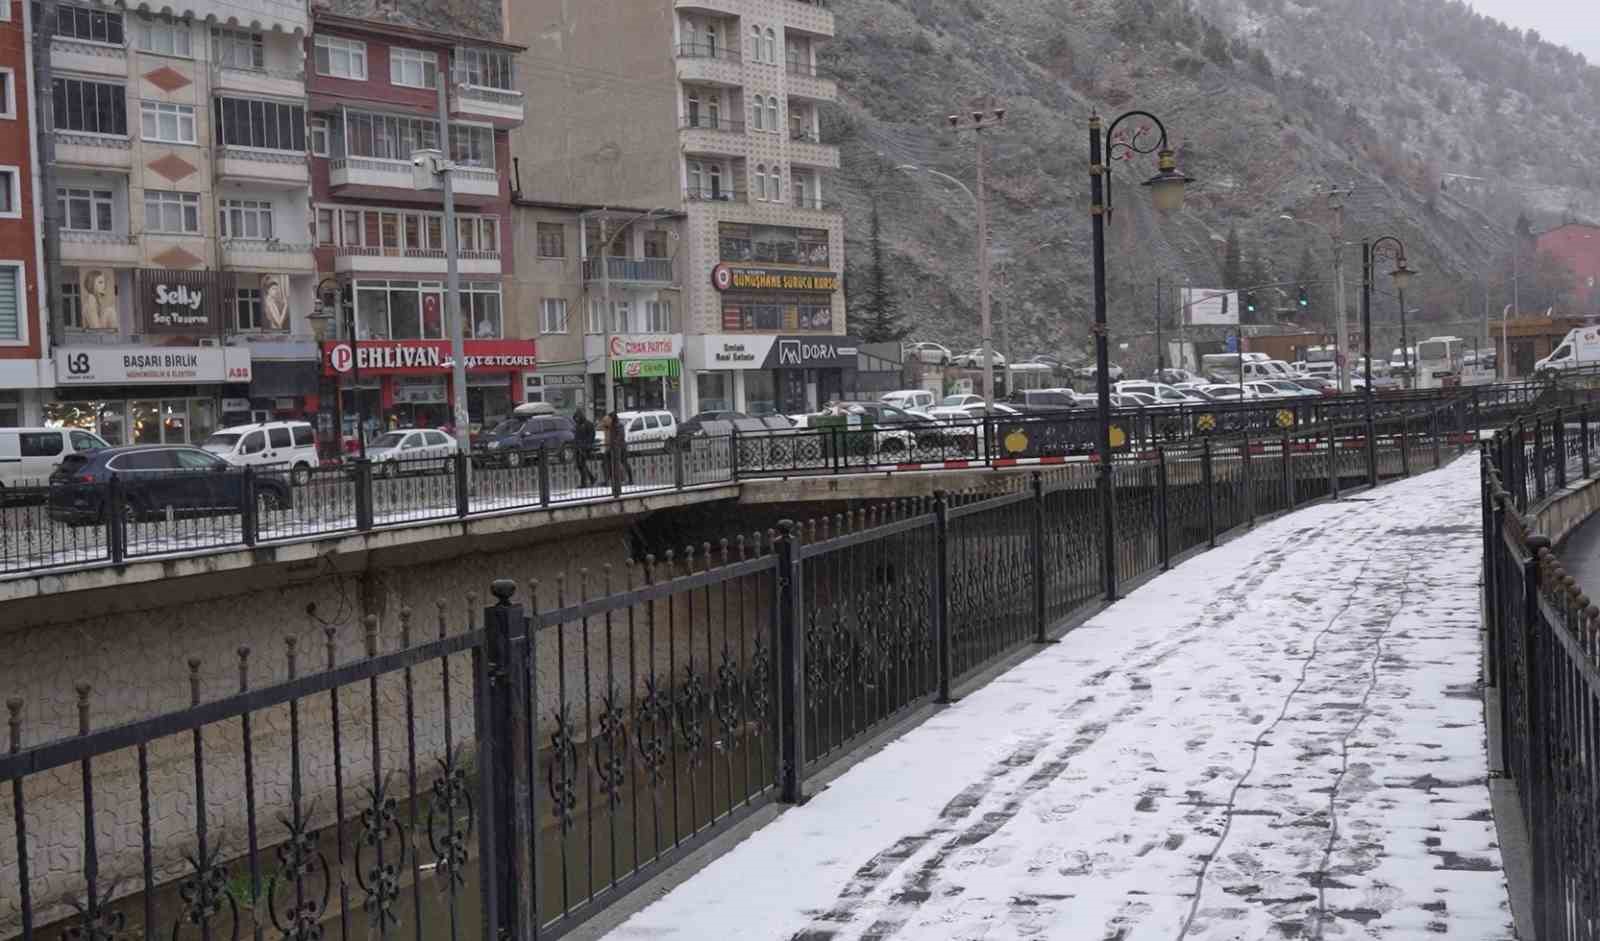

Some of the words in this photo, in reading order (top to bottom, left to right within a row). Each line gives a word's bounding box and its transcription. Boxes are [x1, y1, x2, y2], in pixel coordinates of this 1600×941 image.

[802, 344, 836, 359] DORA
[124, 355, 161, 369] BAŞARI
[165, 354, 197, 367] BİRLİK
[229, 368, 249, 377] ABB
